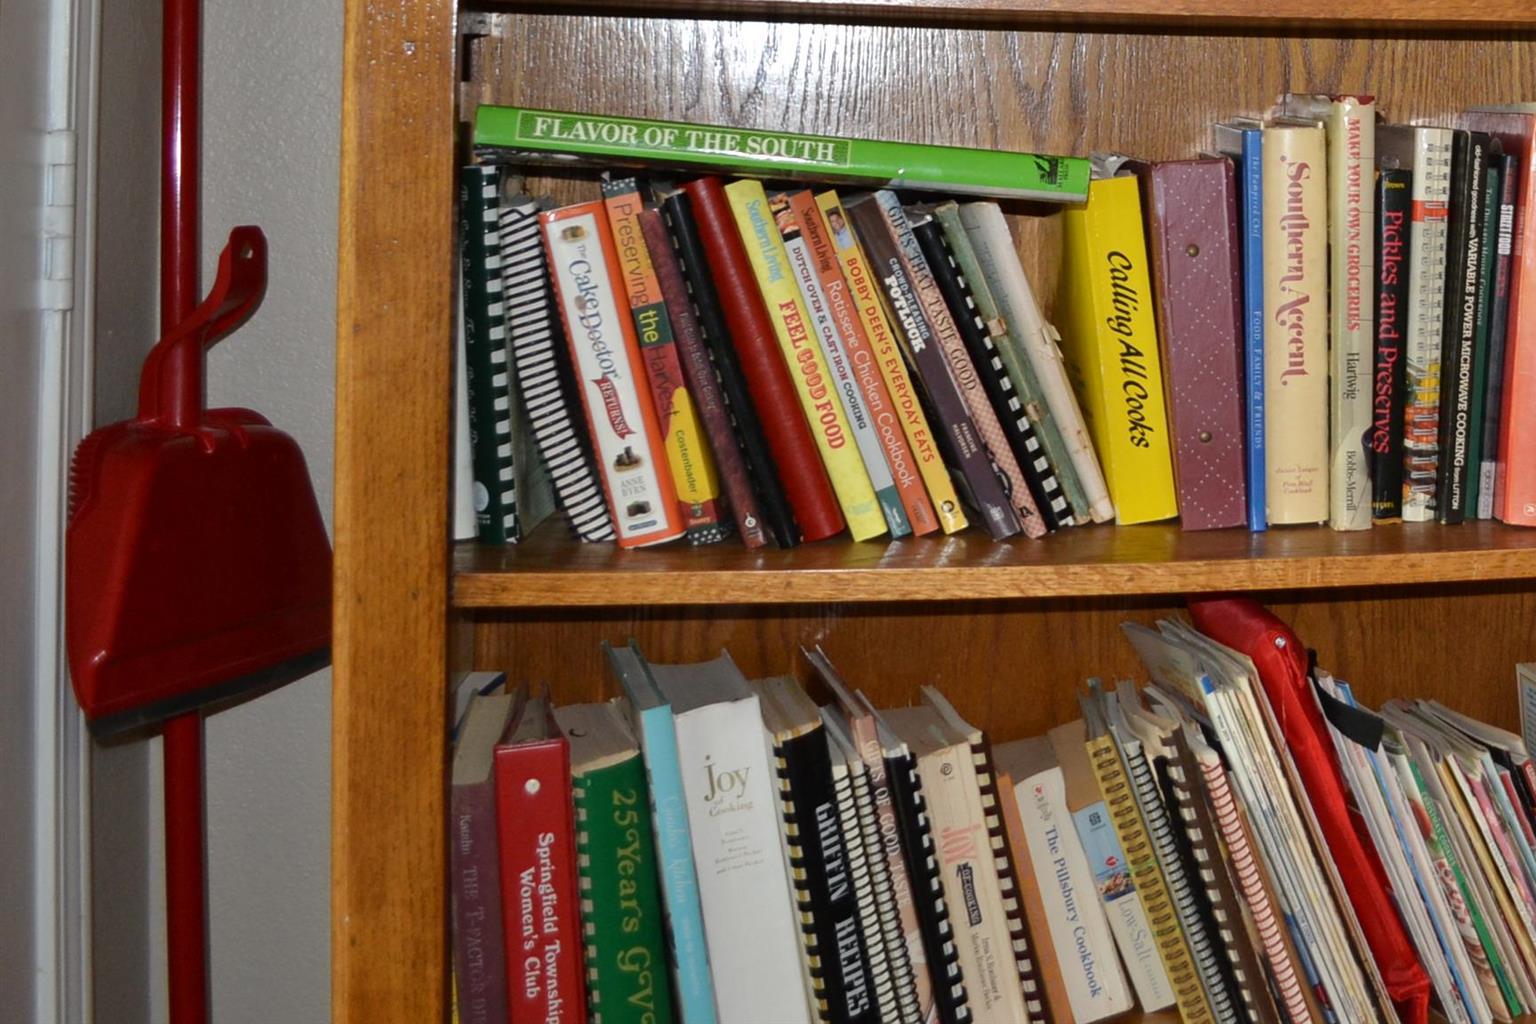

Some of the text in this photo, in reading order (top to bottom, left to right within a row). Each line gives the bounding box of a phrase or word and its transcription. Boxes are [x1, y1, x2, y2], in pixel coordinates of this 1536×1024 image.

[533, 116, 836, 162] FLAVOR OF THE SOUTH
[746, 199, 785, 283] Southern Living
[1275, 154, 1311, 386] Southern Accent
[1347, 117, 1361, 331] MAKE YOUR OWN GROCERIES
[1381, 209, 1403, 285] Pickles
[1498, 233, 1512, 255] FOOD
[1499, 204, 1514, 233] STREET
[568, 259, 620, 380] Cake Doctor
[612, 202, 681, 418] Preserving the Harvest
[792, 246, 867, 430] DUTCH OVEN CAST IRON COOKING
[885, 275, 927, 353] POTLUCK
[887, 206, 977, 392] GIFTS THAT TASTE GOOD
[889, 257, 929, 340] CROWD-PLEASING
[1106, 250, 1154, 449] Calling All Cooks
[1378, 293, 1400, 338] and
[600, 380, 629, 436] RETURNS!
[779, 298, 845, 450] FEEL GOOD FOOD
[826, 278, 912, 489] Rotisserie Chicken Cookbook
[846, 257, 872, 305] BOBBY
[865, 307, 892, 354] DEEN'S
[886, 357, 920, 432] EVERYDAY
[913, 427, 936, 463] EATS
[1252, 311, 1263, 449] FOOD, FAMILY FRIENDS
[1342, 351, 1360, 400] Hartwig
[1374, 345, 1398, 453] Preserves
[1452, 237, 1478, 510] VARIABLE POWER MICROWAVE COOKING LITTON
[675, 429, 698, 494] Costenbader
[1345, 450, 1358, 511] Bobbs-Merrill
[703, 754, 752, 802] joy
[865, 739, 901, 858] GIFTS OF GOOD
[464, 865, 478, 900] THE
[612, 789, 643, 933] 25 Years
[815, 801, 870, 1018] GRIFFIN RECIPES
[1044, 824, 1059, 856] The
[1053, 856, 1079, 922] Pillsbury
[1073, 924, 1102, 999] Cookbook
[520, 865, 541, 999] Women's Club
[535, 832, 564, 1024] Springfield Township
